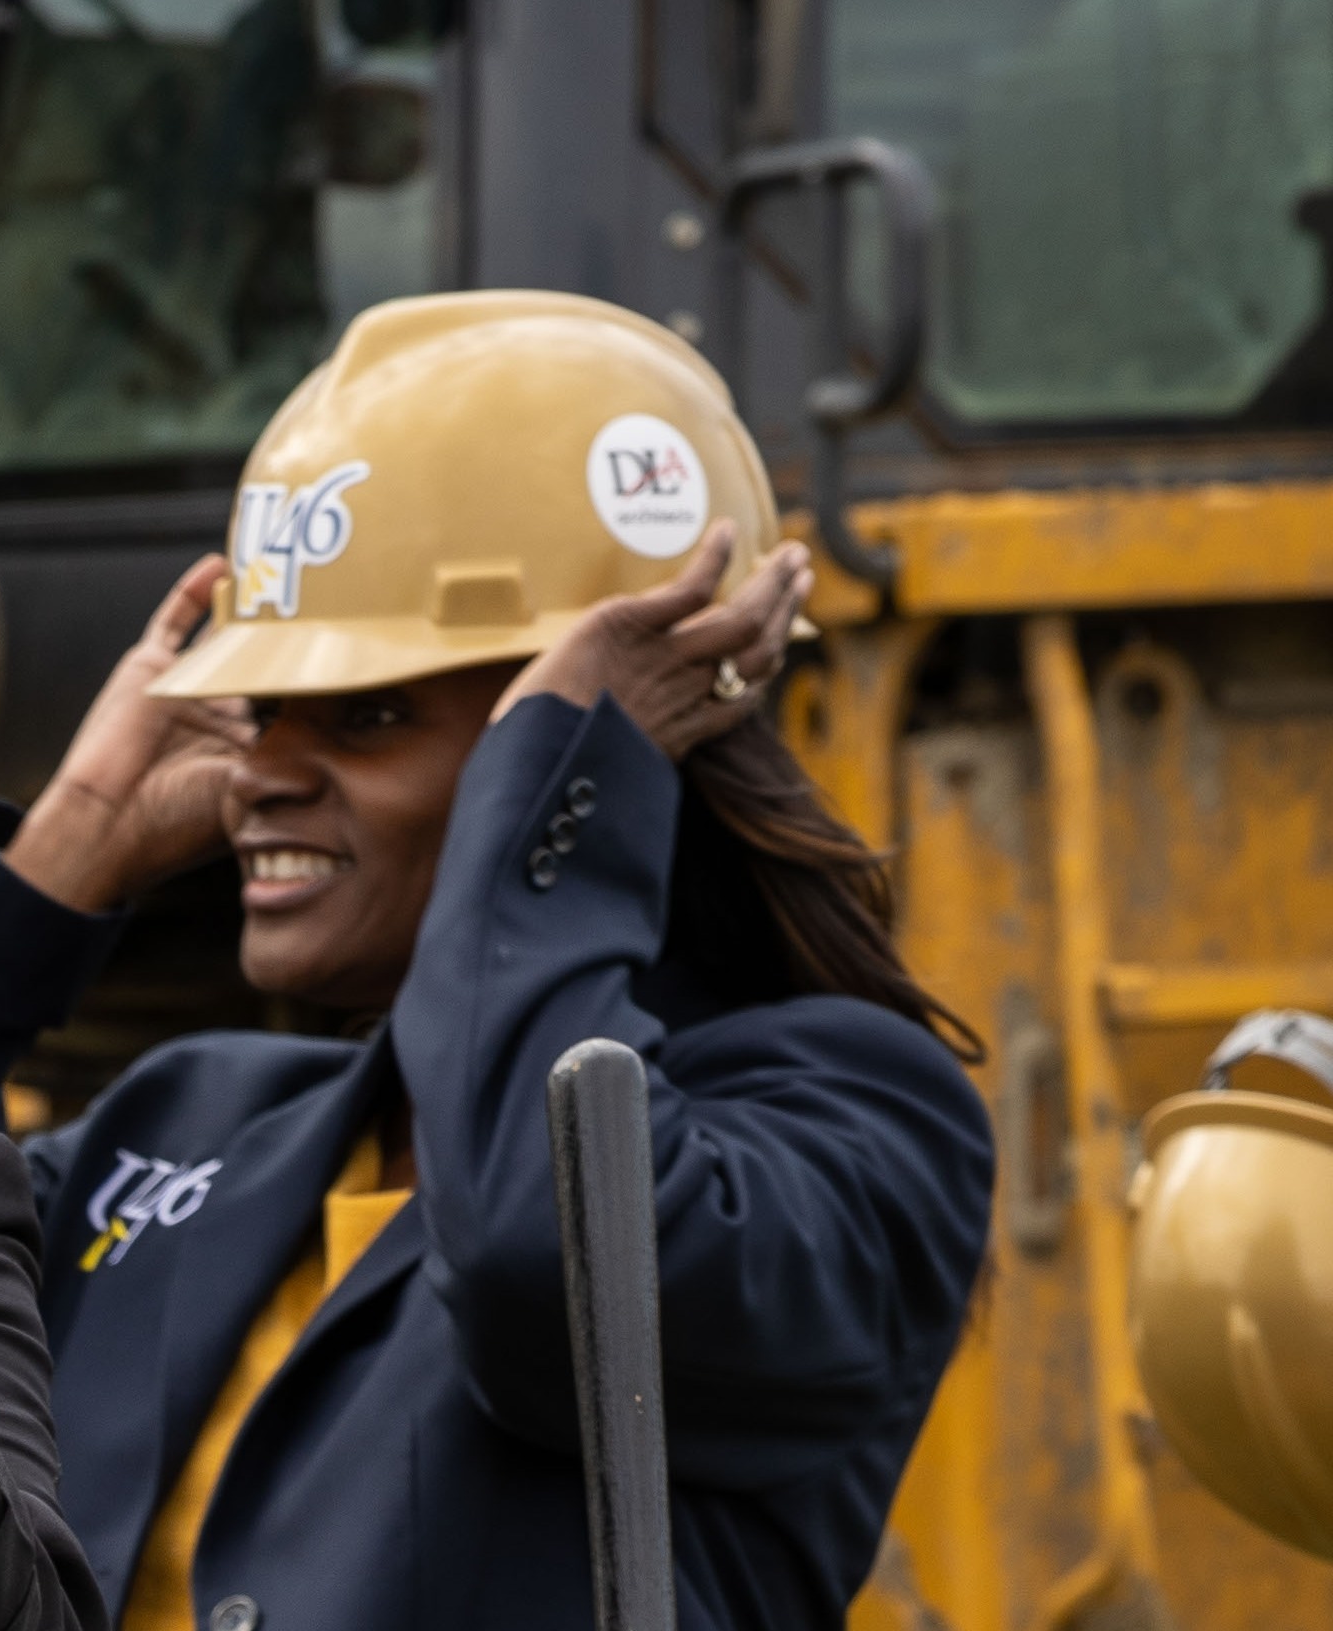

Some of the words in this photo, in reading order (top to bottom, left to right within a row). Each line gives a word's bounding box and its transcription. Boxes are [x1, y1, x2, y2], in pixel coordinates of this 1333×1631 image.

[606, 446, 690, 497] DLA
[236, 469, 361, 607] U46
[87, 1148, 223, 1266] U46
